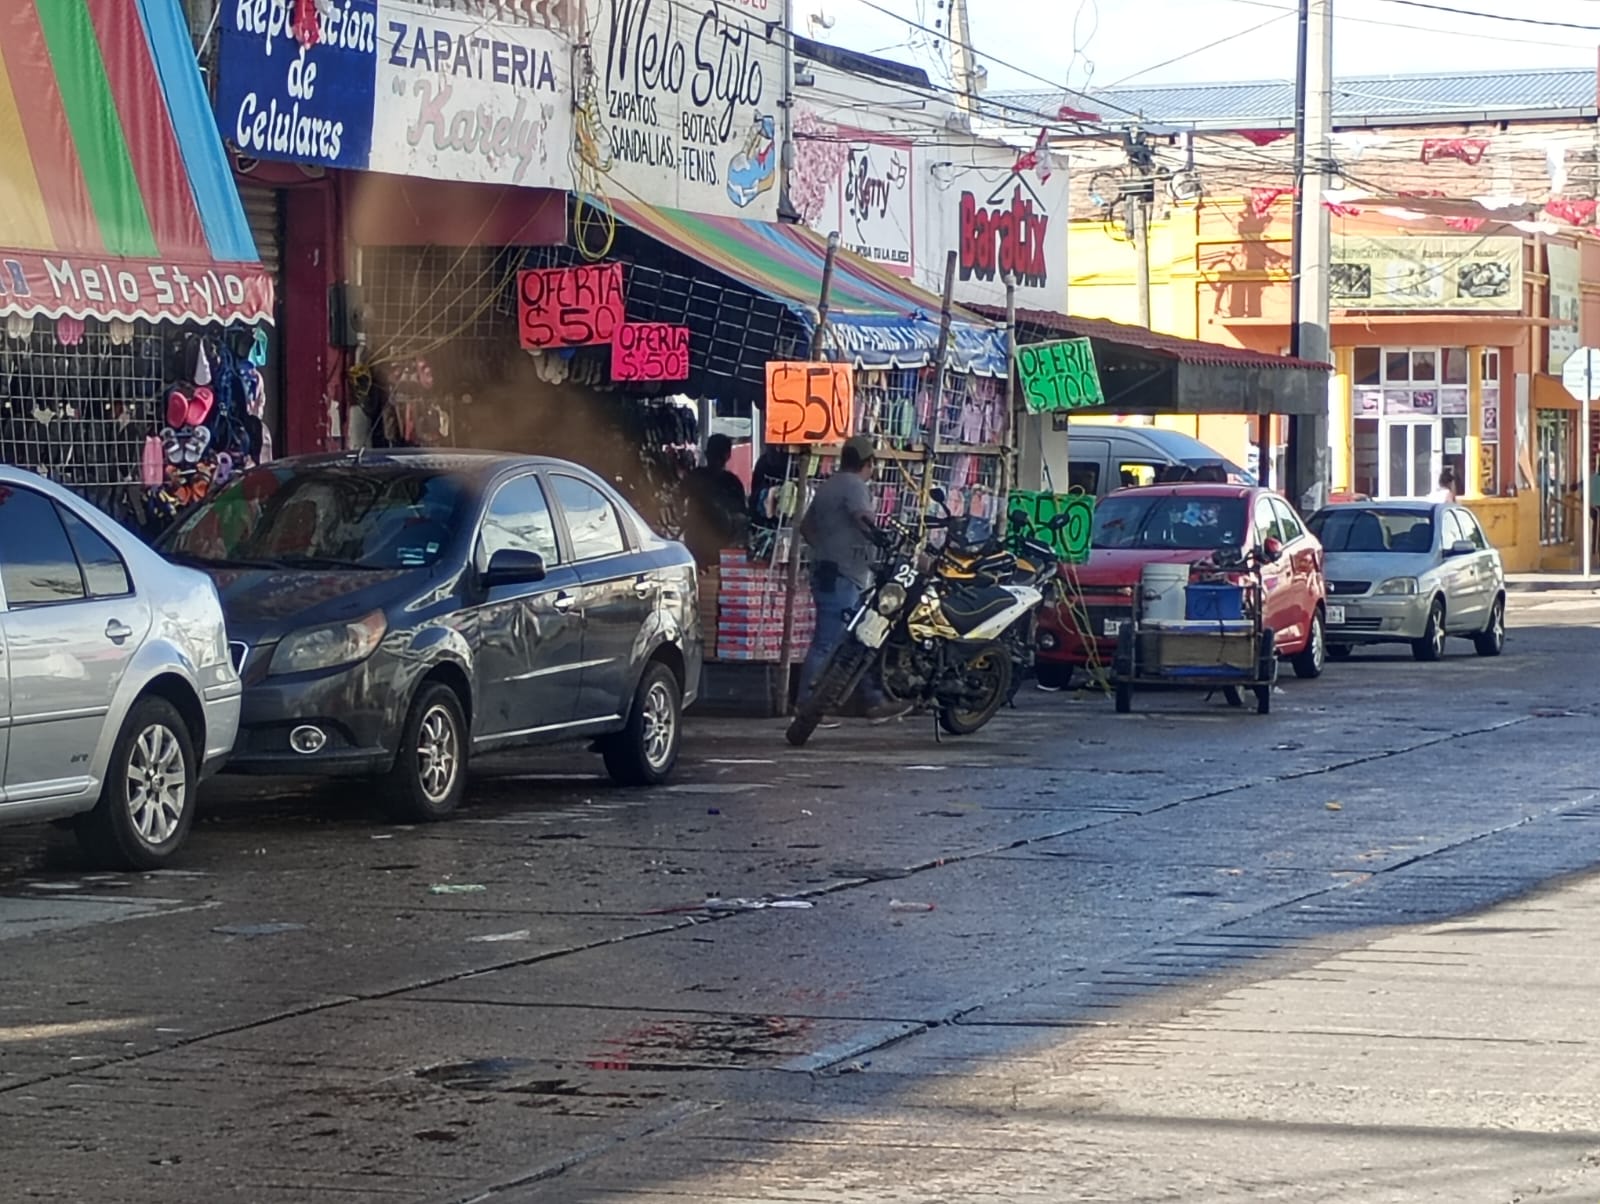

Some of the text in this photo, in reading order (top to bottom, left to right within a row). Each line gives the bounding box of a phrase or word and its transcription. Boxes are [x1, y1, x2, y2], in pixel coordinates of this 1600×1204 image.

[287, 46, 317, 100] de
[388, 21, 556, 92] ZAPATERIA
[605, 0, 763, 143] Melo Stylo
[236, 92, 344, 160] Celulares
[958, 183, 1049, 288] Baratix
[43, 257, 245, 316] Melo Stylo
[521, 266, 625, 307] OFERTA
[525, 304, 616, 346] $50
[619, 323, 690, 352] OFERTA
[772, 362, 851, 442] $50
[1028, 371, 1100, 411] $100
[894, 564, 919, 588] 25
